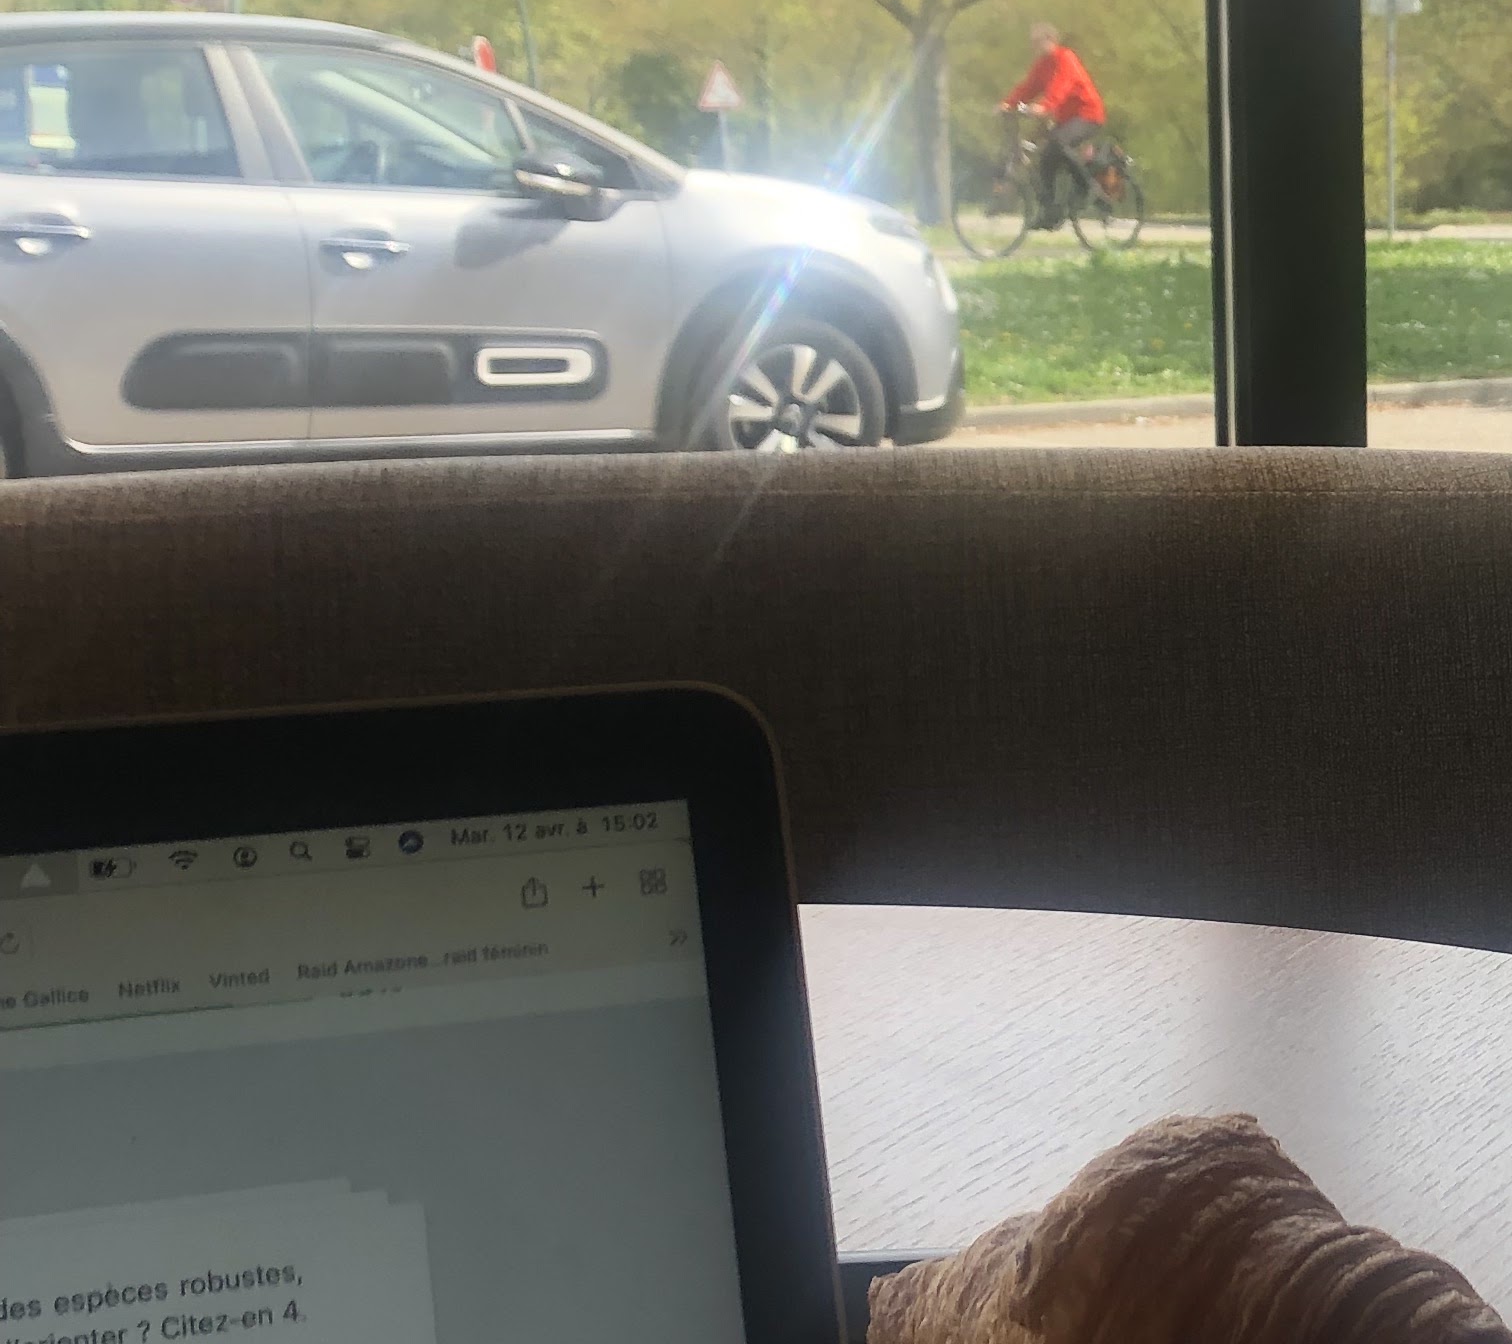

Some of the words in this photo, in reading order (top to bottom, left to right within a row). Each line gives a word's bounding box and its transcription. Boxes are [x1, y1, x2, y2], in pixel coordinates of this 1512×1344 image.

[503, 823, 527, 841] 12
[118, 977, 181, 998] Netflix
[209, 968, 270, 989] Vinted
[54, 1281, 168, 1315] espèces
[180, 1263, 304, 1297] robustes,
[137, 1320, 151, 1344] ?
[161, 1306, 273, 1340] Citez-en
